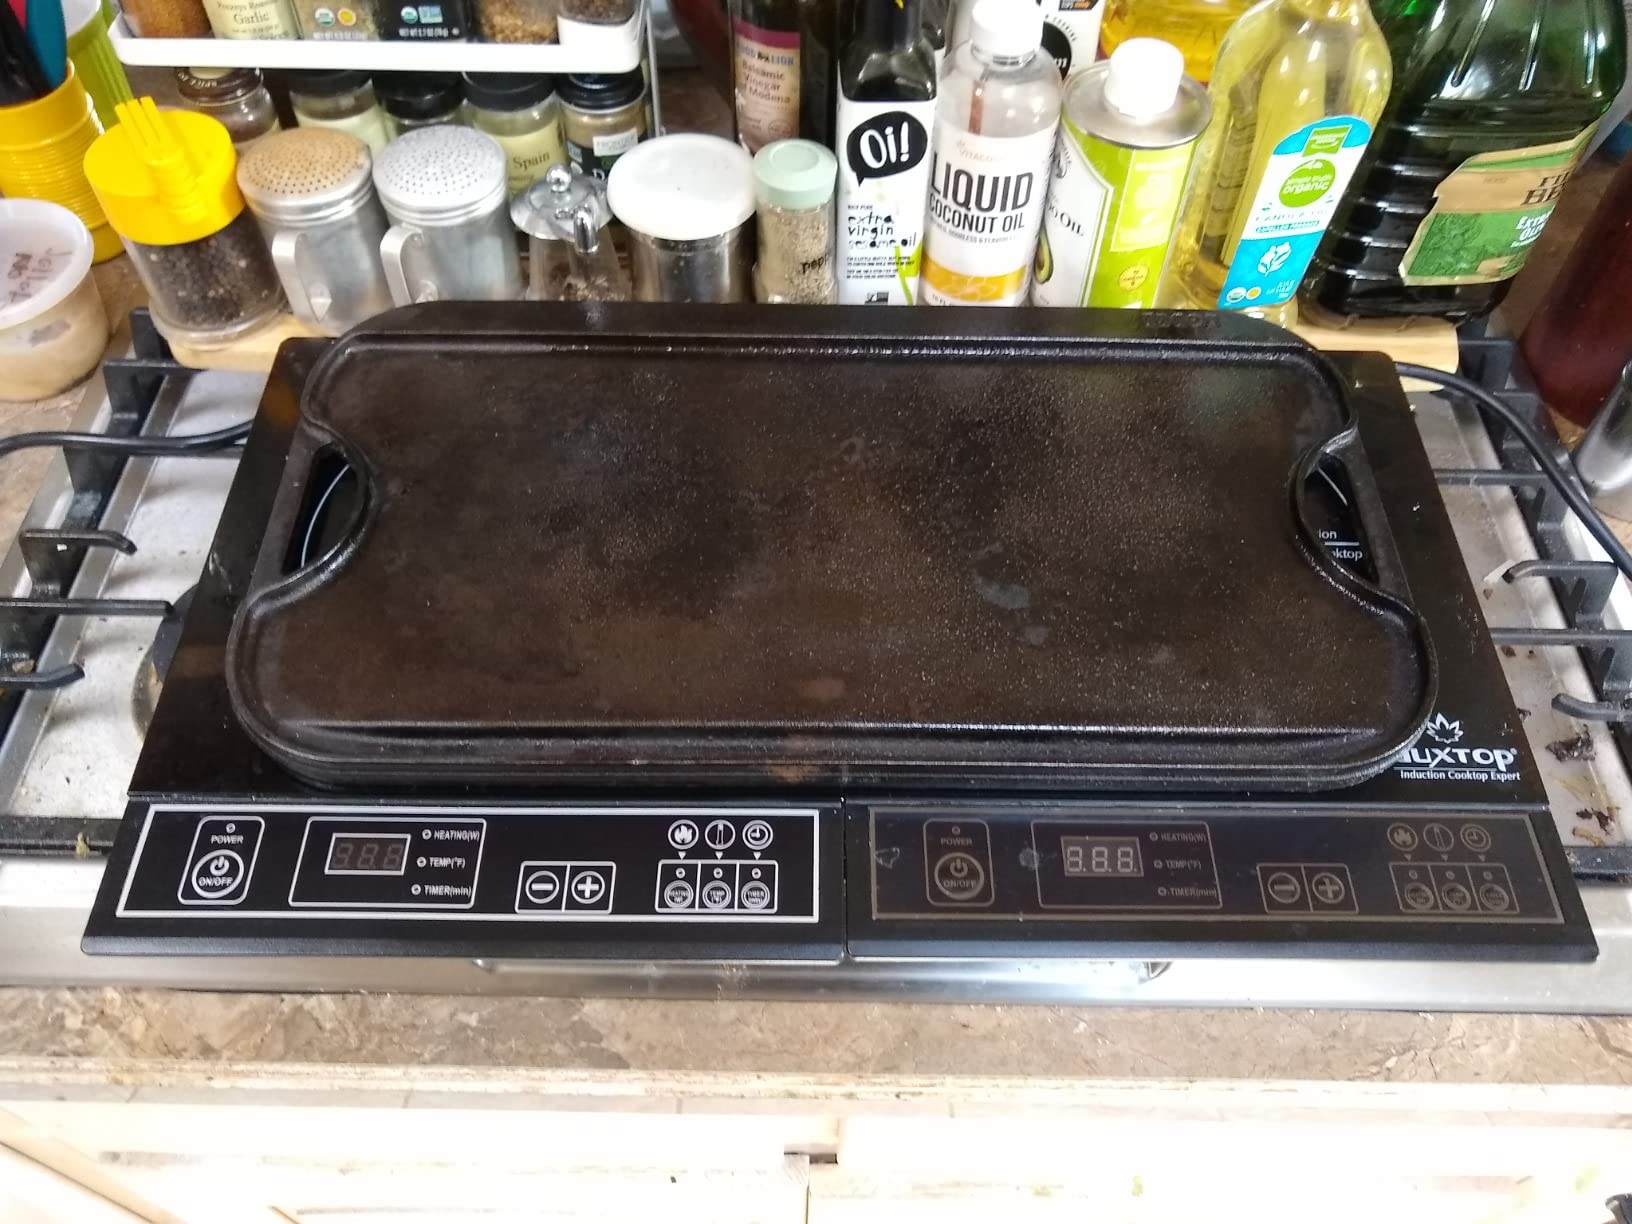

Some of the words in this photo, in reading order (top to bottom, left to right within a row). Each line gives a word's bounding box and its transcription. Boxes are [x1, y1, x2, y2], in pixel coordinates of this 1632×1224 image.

[233, 9, 271, 26] Garlic
[742, 59, 785, 80] Balsamic
[744, 72, 782, 92] Vinegar
[749, 85, 791, 104] Modena
[860, 121, 910, 169] Oi!
[512, 150, 550, 171] Spain
[930, 151, 1034, 213] LIQUID
[1282, 180, 1331, 195] organic
[848, 212, 895, 225] extra
[928, 192, 998, 234] COCONUT
[1001, 212, 1025, 233] OIL
[848, 225, 894, 240] virgin
[848, 239, 898, 250] sesame
[901, 232, 917, 247] oil
[1400, 769, 1446, 780] Induction
[1447, 770, 1489, 783] Cooktop
[1490, 771, 1521, 783] Expert
[210, 834, 244, 845] POWER
[433, 829, 480, 842] HEATING(W)
[940, 836, 973, 846] POWER
[198, 876, 234, 887] ON/OFF
[942, 879, 977, 889] ON/OFF
[424, 884, 472, 898] TIMER(min)
